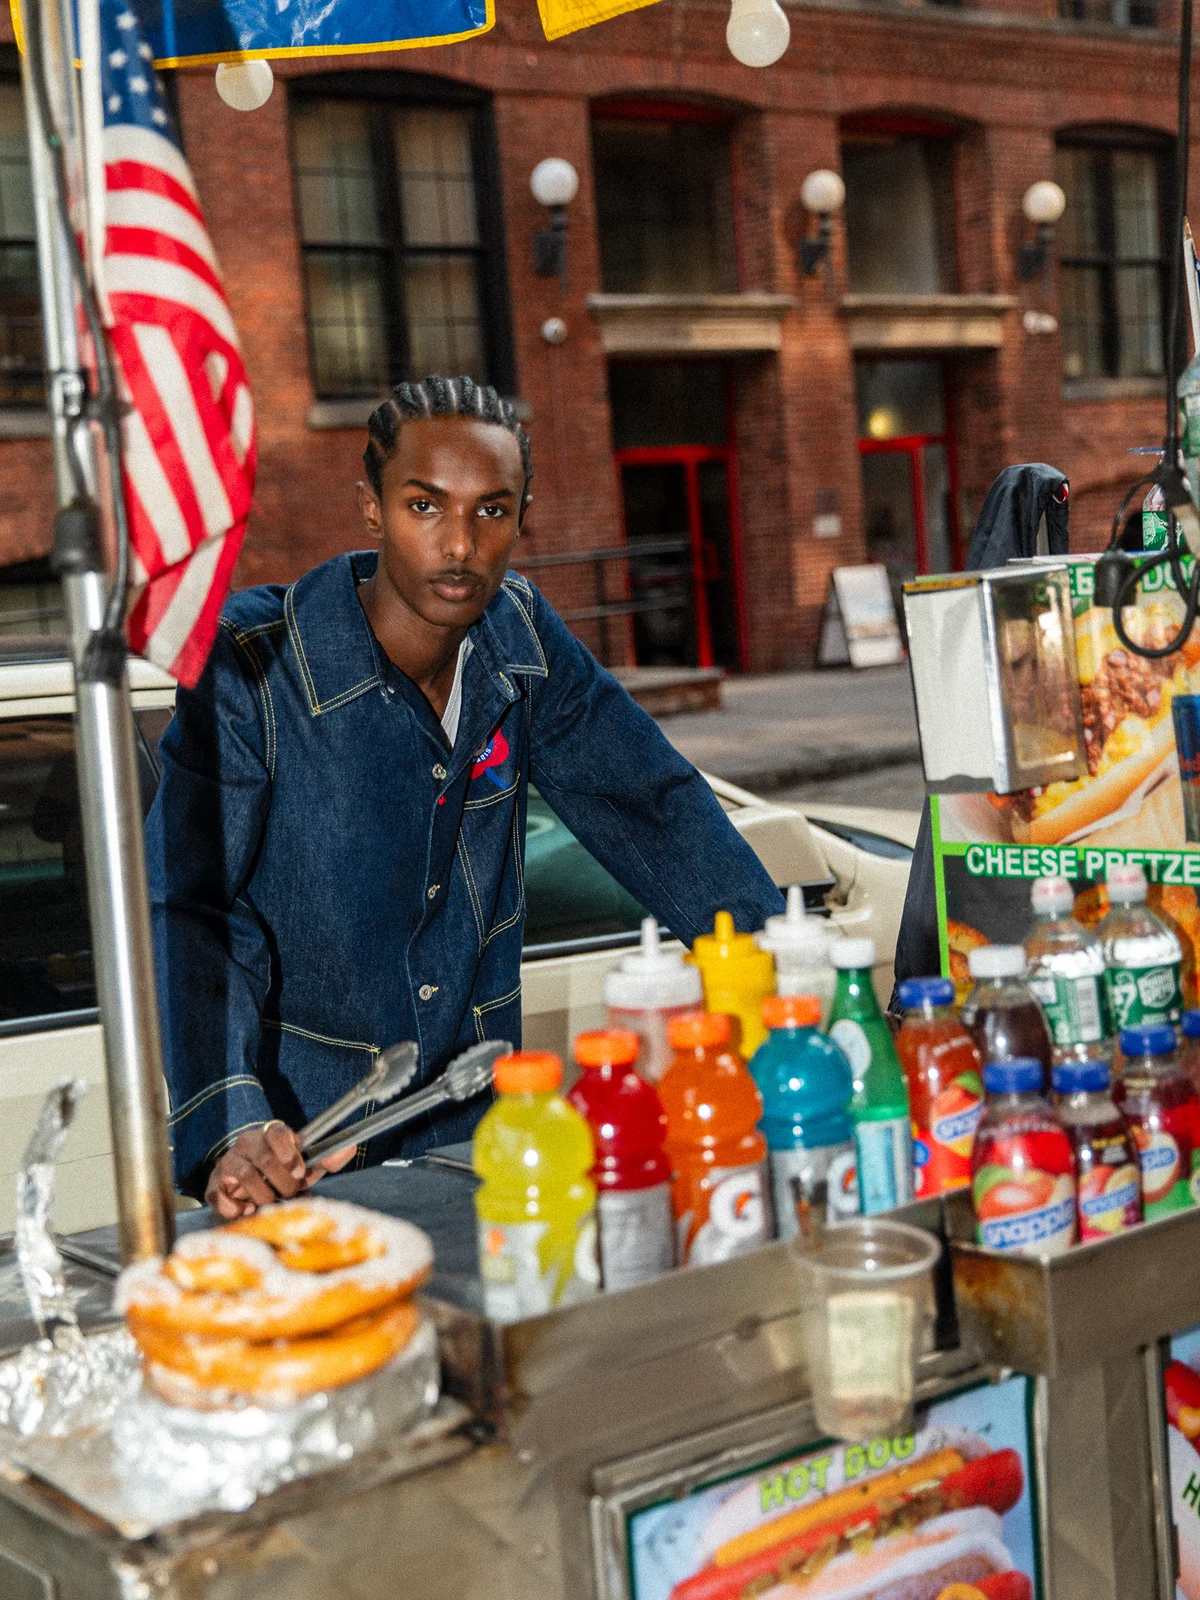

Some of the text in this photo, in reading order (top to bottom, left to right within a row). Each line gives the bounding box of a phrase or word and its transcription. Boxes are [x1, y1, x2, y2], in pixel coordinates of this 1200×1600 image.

[966, 846, 1078, 879] CHEESE
[760, 1430, 916, 1513] HOT DOG
